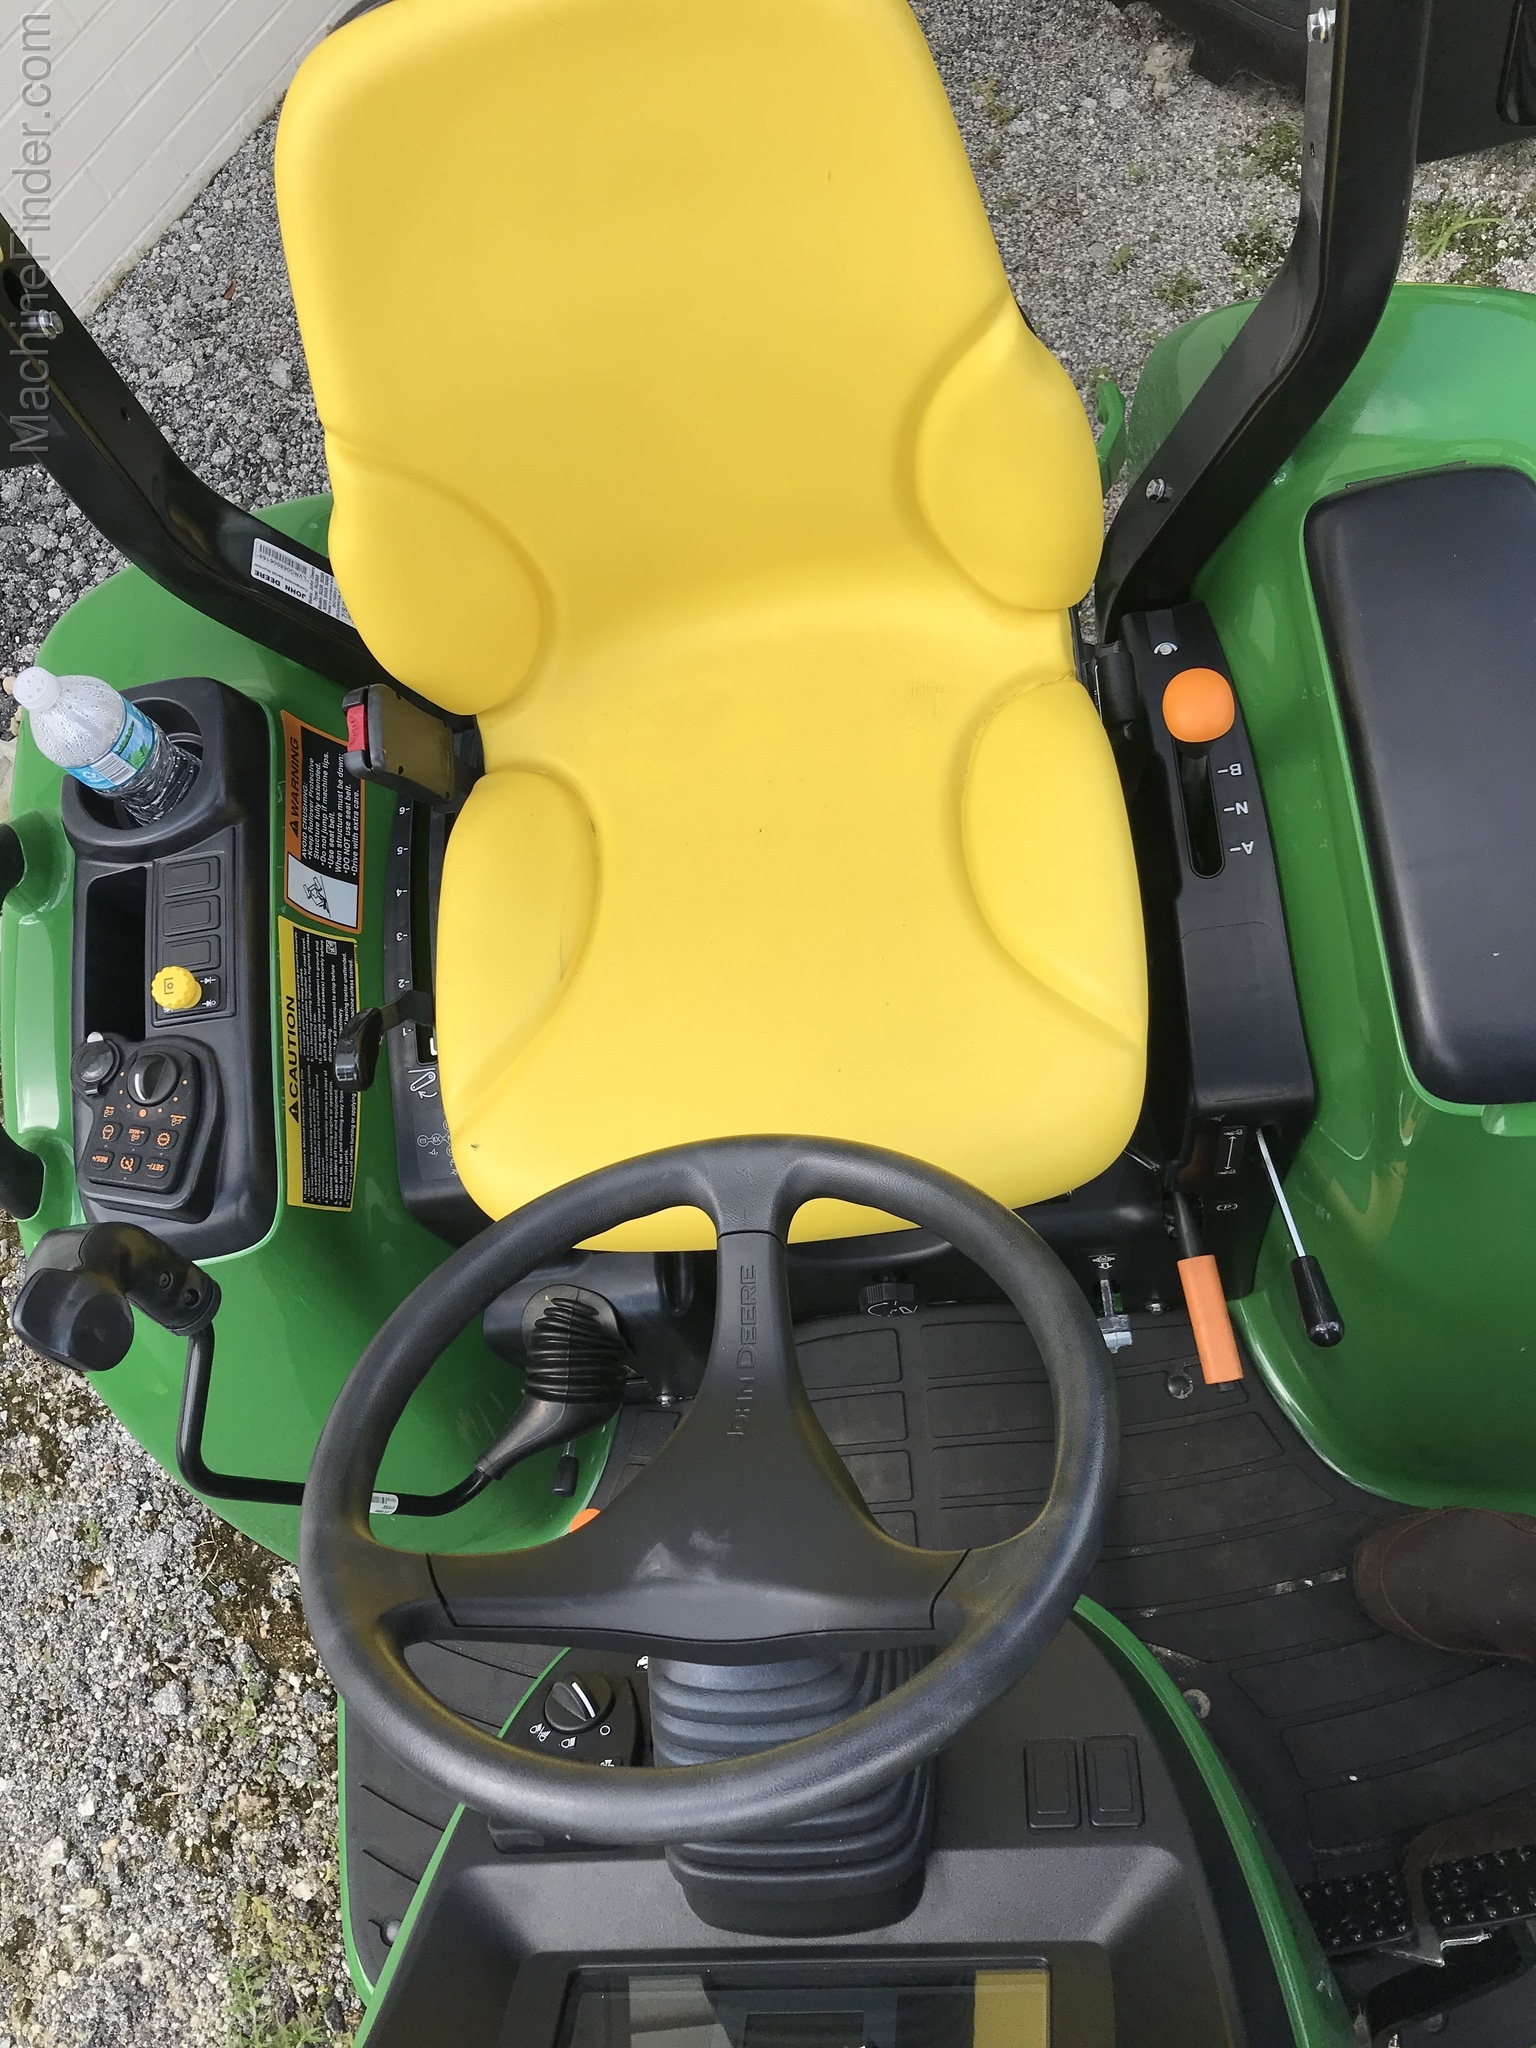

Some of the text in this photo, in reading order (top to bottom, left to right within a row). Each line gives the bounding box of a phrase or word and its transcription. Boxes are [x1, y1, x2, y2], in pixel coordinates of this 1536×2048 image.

[254, 570, 280, 586] DEERE
[284, 585, 306, 598] JOHN
[322, 752, 330, 768] tips.
[1230, 763, 1242, 776] B
[290, 737, 299, 816] WARNING
[337, 779, 343, 789] be
[398, 806, 405, 815] 6
[1235, 801, 1248, 815] N
[397, 846, 403, 855] 5
[1241, 840, 1254, 855] A
[320, 851, 326, 862] Do
[343, 857, 350, 870] DO
[396, 932, 403, 941] 3
[398, 979, 405, 988] 2
[286, 996, 298, 1098] CAUTION
[147, 1163, 164, 1171] SET/-
[727, 1265, 756, 1443] JOHN DEERE
